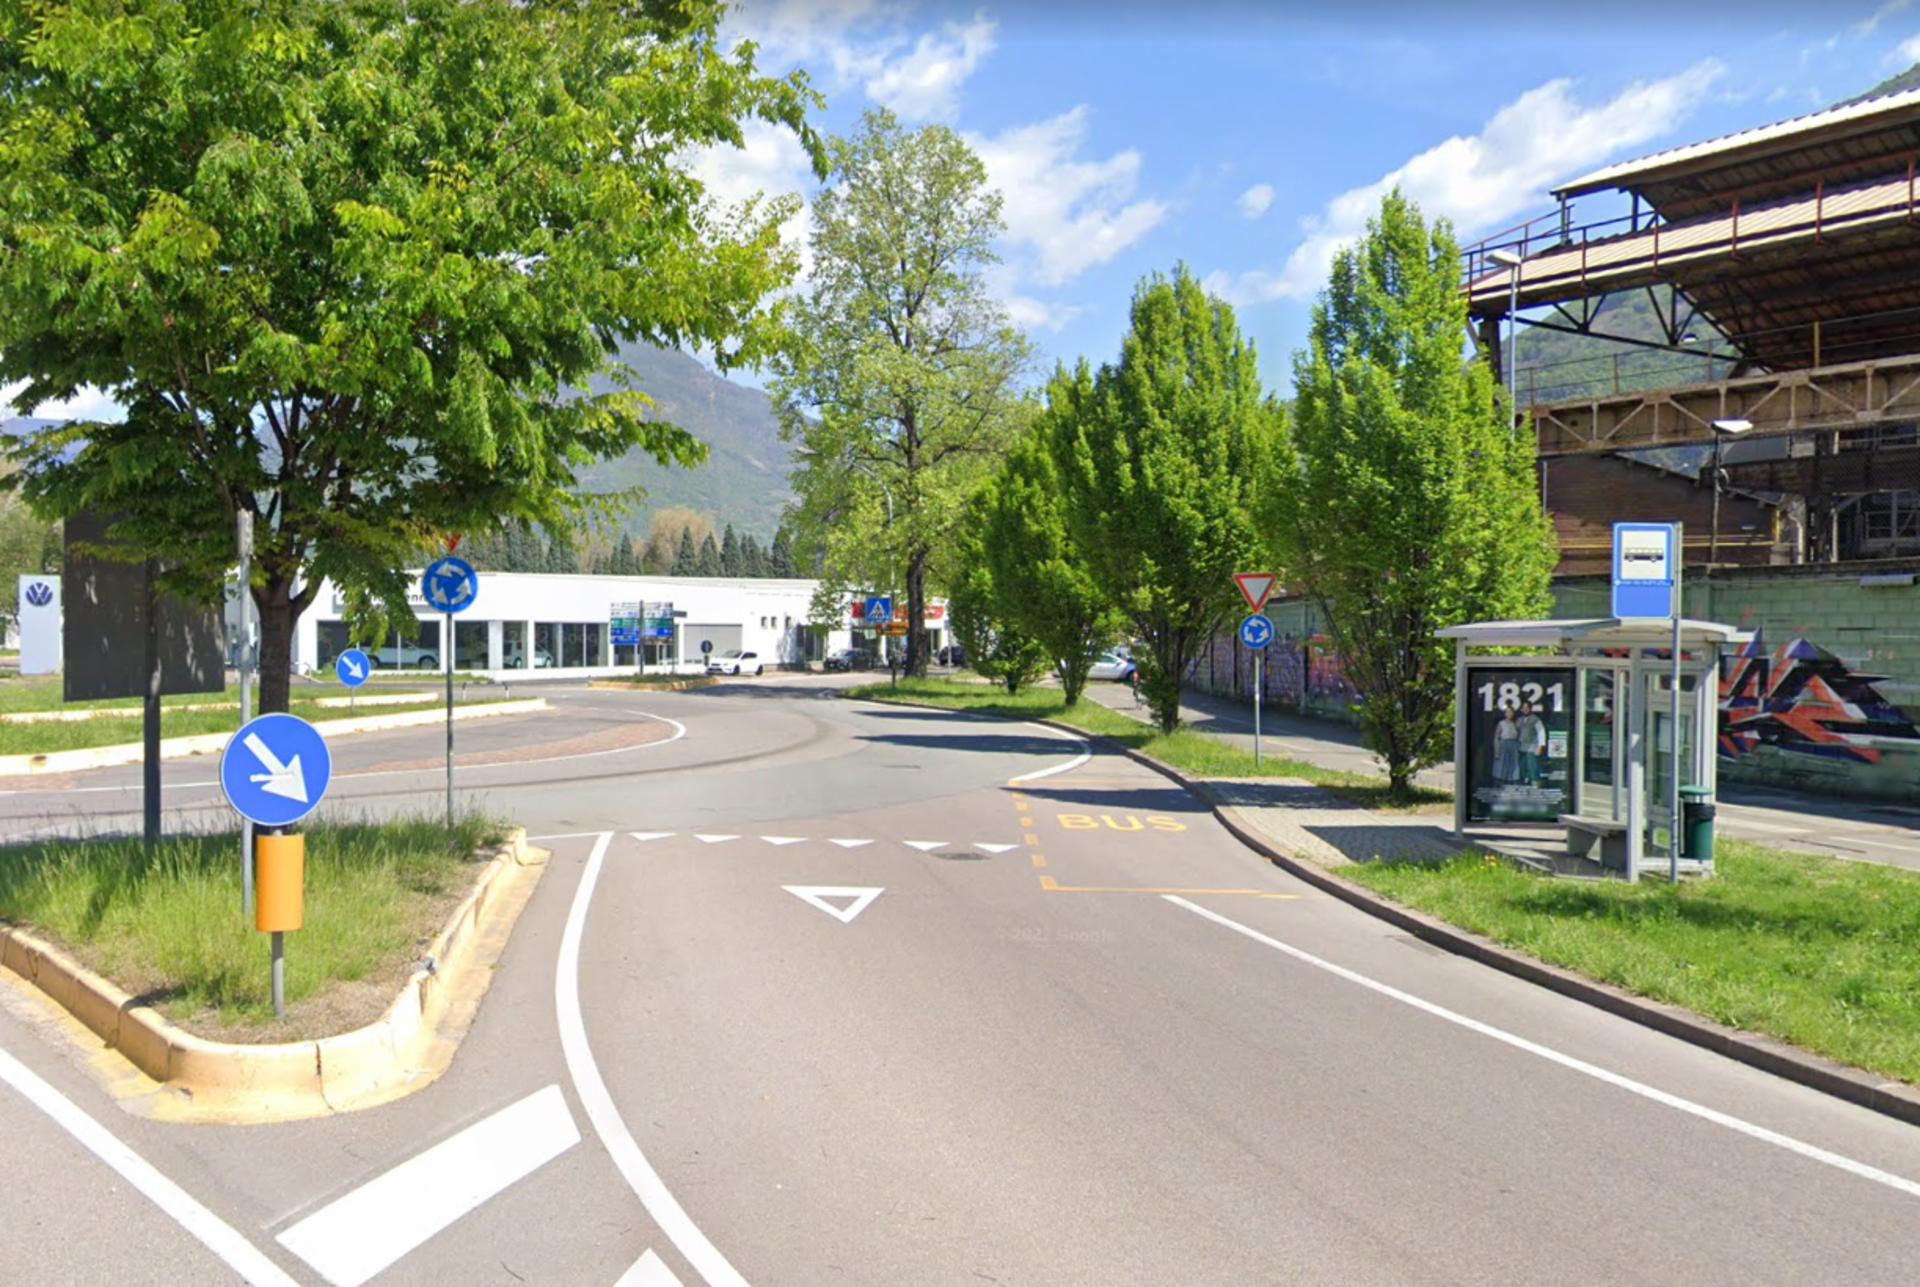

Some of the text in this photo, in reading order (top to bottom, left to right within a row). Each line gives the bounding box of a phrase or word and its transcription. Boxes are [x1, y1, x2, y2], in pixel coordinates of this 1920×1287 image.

[26, 582, 53, 606] VW
[1478, 682, 1564, 712] 1821
[1057, 813, 1186, 831] BUS
